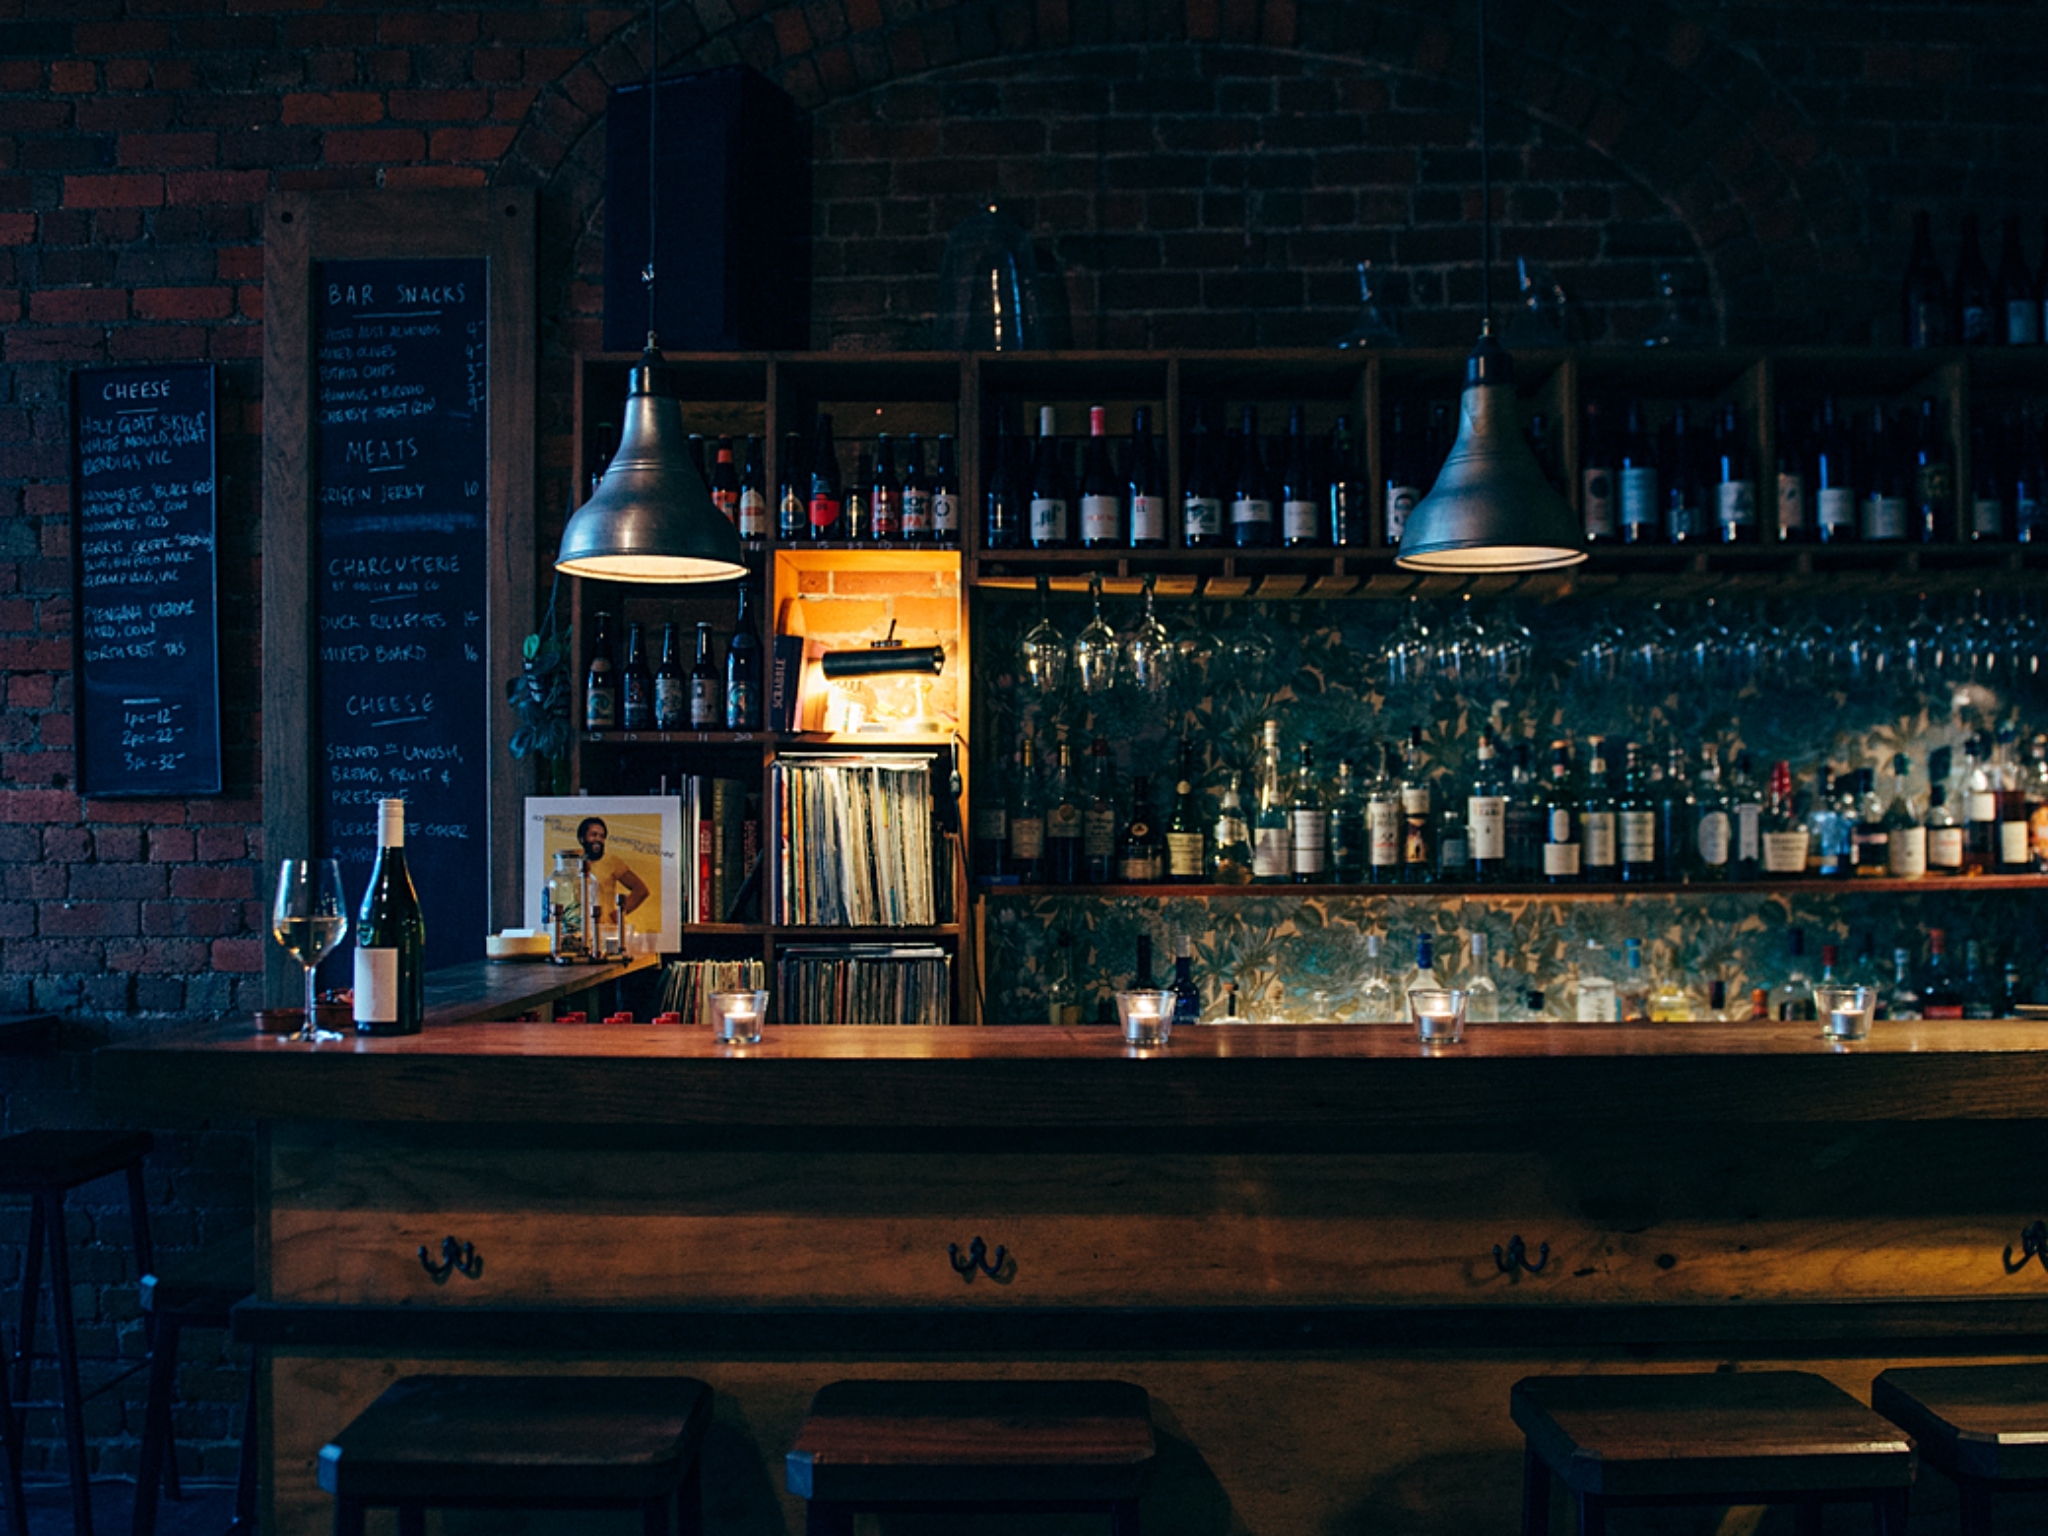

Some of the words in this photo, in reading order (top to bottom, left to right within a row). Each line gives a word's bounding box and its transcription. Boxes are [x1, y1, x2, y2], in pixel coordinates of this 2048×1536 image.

[328, 283, 375, 306] BAR
[397, 282, 466, 304] SNACKS
[102, 380, 171, 400] CHEESE
[118, 415, 156, 434] GOAT
[145, 450, 172, 466] VIC
[346, 437, 418, 464] MEATS
[381, 482, 426, 504] JERKY
[123, 620, 156, 636] COW
[319, 613, 361, 631] DUCK
[319, 644, 369, 662] MIXED
[346, 692, 434, 716] CHEESE
[326, 742, 379, 761] SERVED
[387, 767, 433, 784] FRUIT
